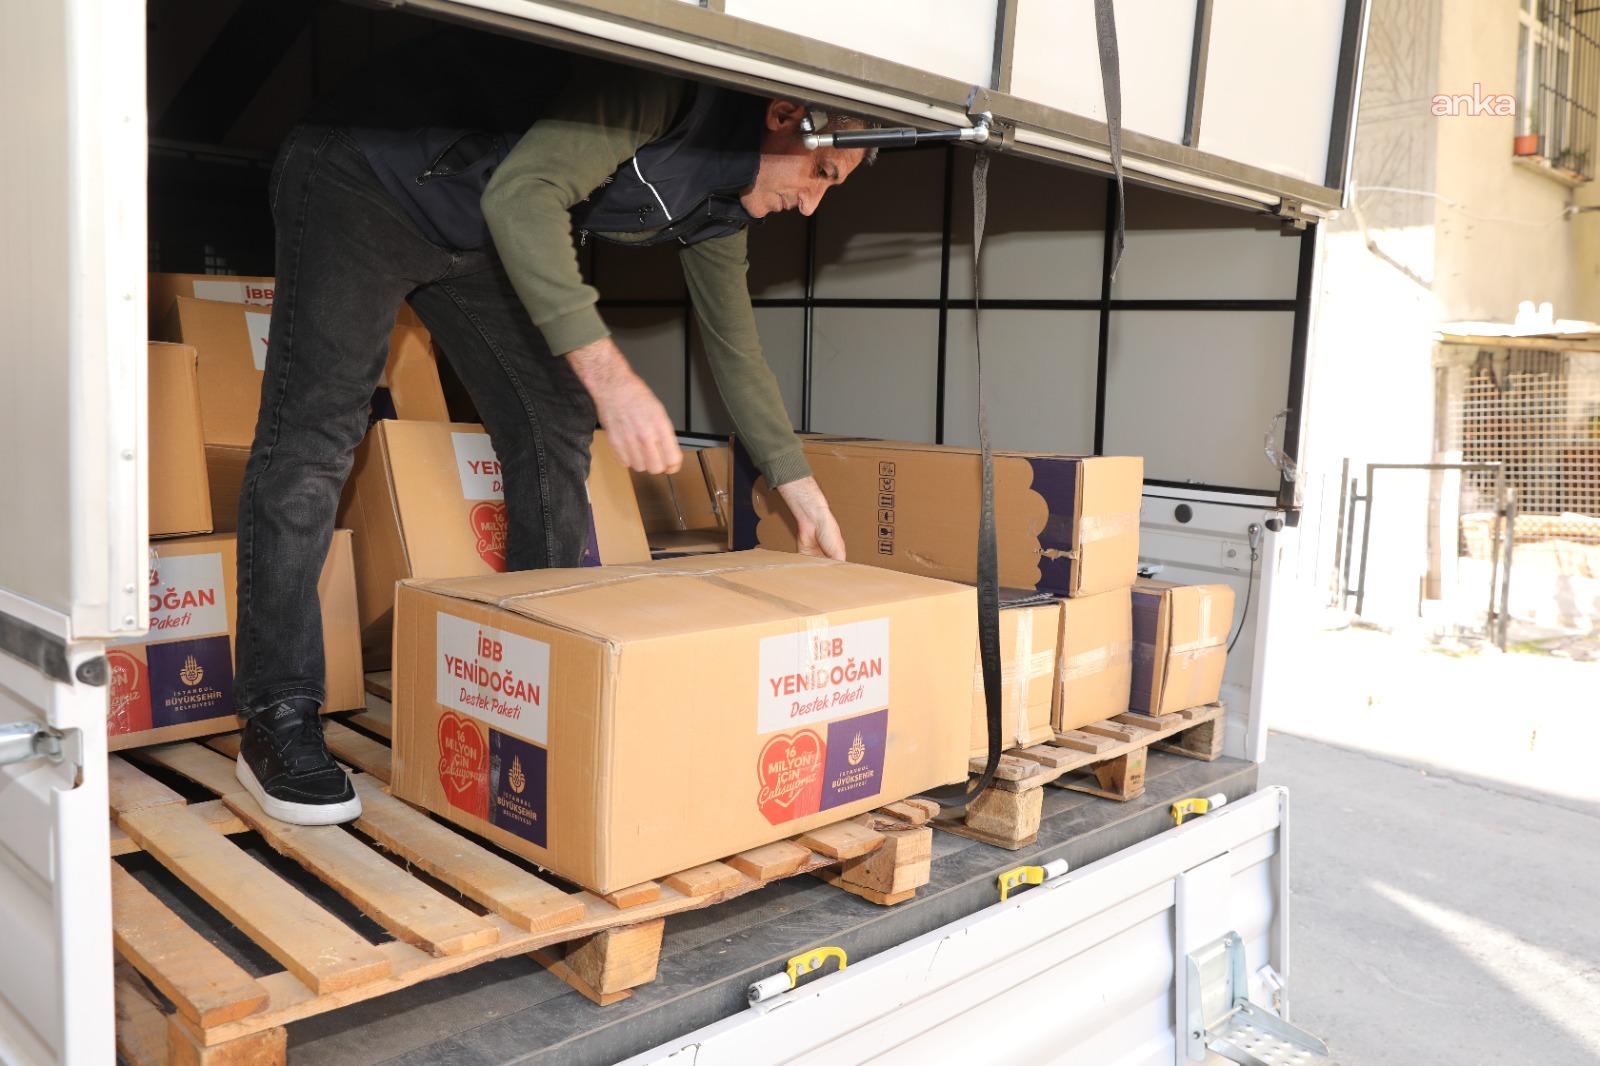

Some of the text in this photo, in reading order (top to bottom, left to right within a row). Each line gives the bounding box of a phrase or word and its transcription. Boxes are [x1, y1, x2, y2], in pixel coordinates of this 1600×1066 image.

[246, 285, 274, 299] İBB
[480, 521, 508, 531] MİLY
[493, 514, 504, 522] 16
[149, 612, 191, 631] Paketi
[477, 630, 502, 663] İBB
[813, 636, 843, 661] İBB
[444, 653, 540, 706] YENİDOĞAN
[769, 657, 882, 697] YENİDOĞAN
[165, 691, 222, 707] BÜYÜKŞEHİR
[459, 687, 521, 720] Destek Paketi
[790, 685, 864, 718] Destek Paketi
[456, 730, 466, 743] 16
[445, 736, 477, 760] MİLYON
[785, 746, 797, 758] 16
[768, 754, 812, 774] MİLYON
[777, 768, 800, 785] İÇİN
[831, 770, 875, 789] BÜYÜKŞEHİR
[497, 796, 537, 821] BÜYÜKŞEHİR
